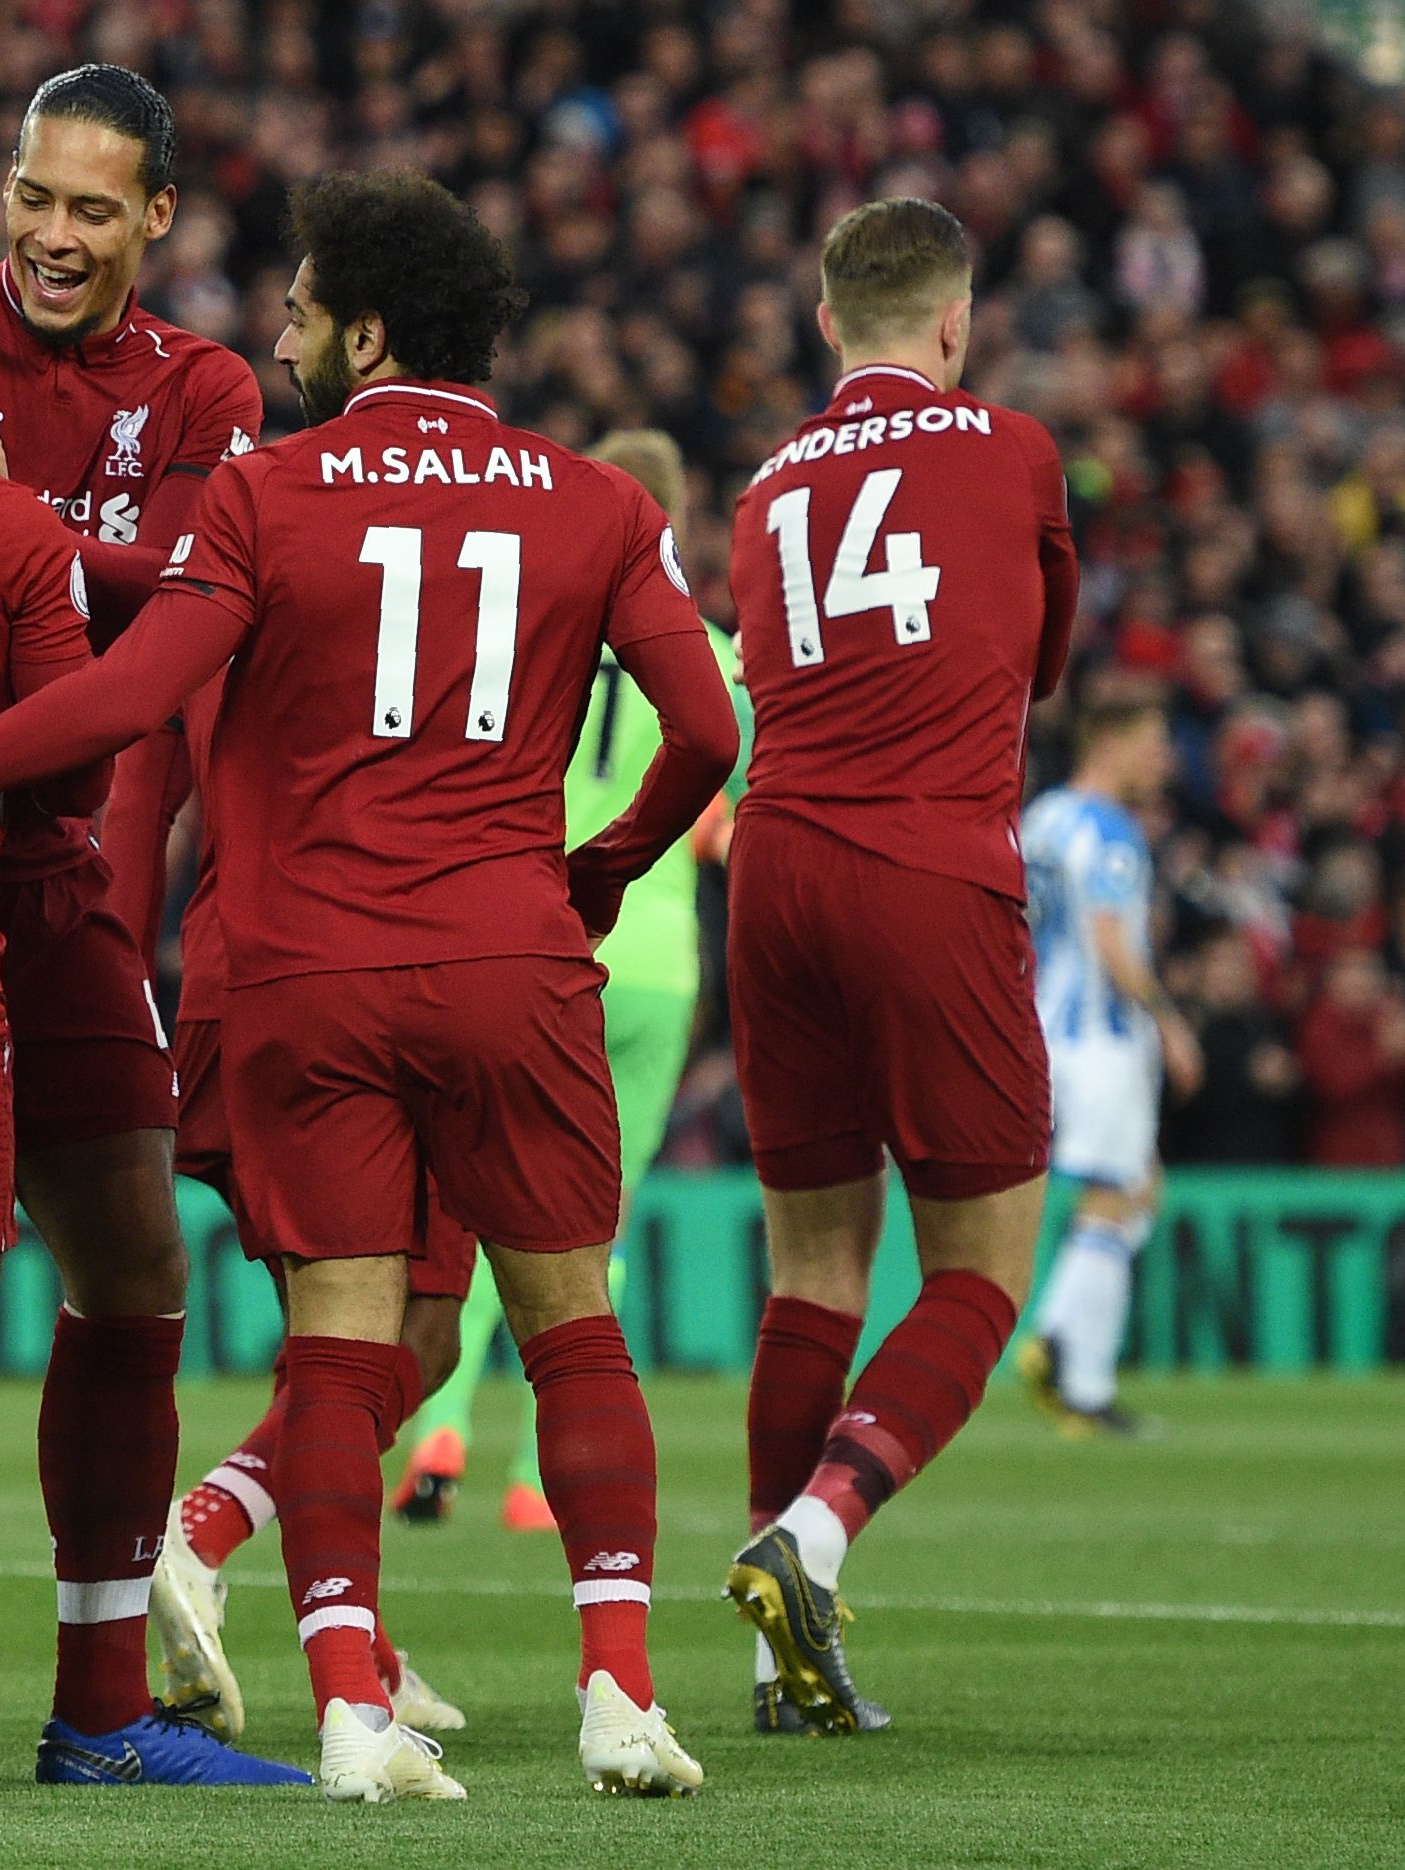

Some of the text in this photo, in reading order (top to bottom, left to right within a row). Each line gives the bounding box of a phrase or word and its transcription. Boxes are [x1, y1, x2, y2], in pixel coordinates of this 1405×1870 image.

[320, 447, 554, 490] M.SALAH
[767, 468, 941, 668] 14
[358, 526, 522, 742] 11
